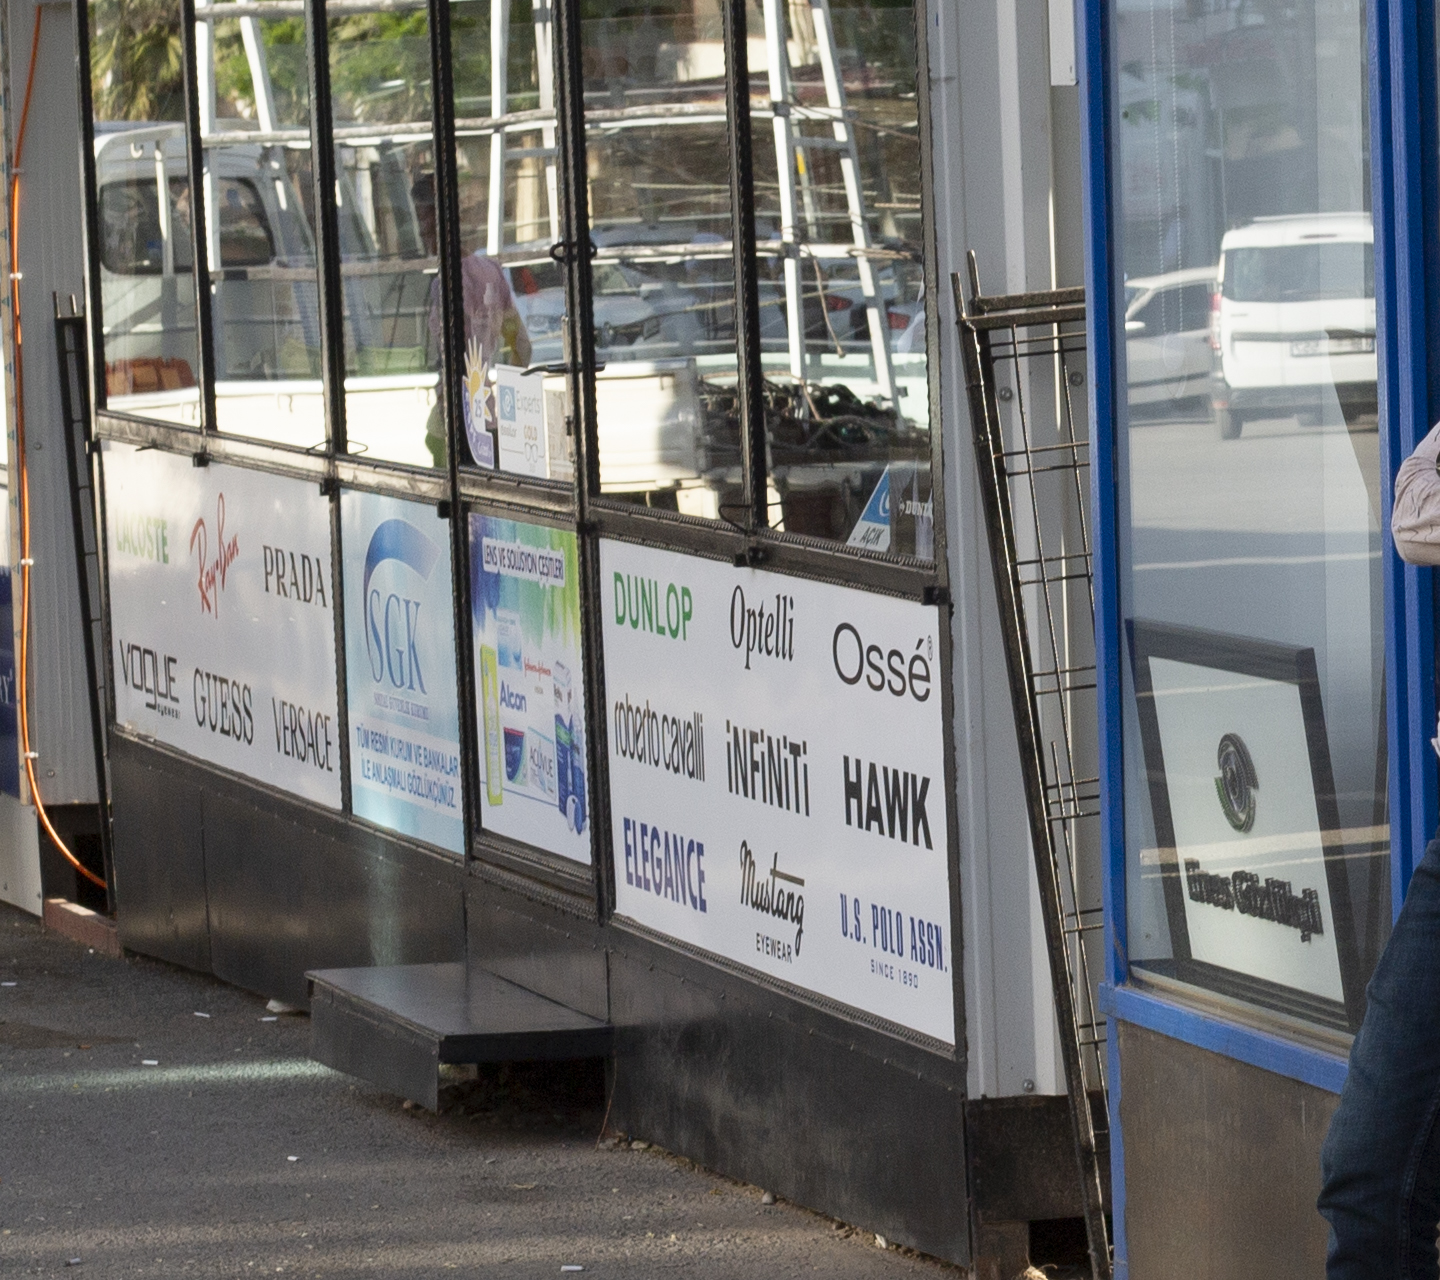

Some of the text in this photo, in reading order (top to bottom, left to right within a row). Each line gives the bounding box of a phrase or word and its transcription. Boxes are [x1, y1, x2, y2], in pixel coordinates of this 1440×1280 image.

[115, 510, 169, 564] LACOSTE
[484, 544, 497, 566] LENS
[498, 547, 506, 568] VE
[860, 526, 885, 549] AÇIK
[262, 545, 327, 608] PRADA
[613, 571, 693, 640] DUNLOP
[370, 589, 427, 695] SGK
[730, 585, 794, 670] Optelli
[833, 622, 931, 702] Ossé
[119, 639, 180, 710] VOGUE
[193, 667, 253, 745] GUESS
[500, 680, 527, 712] Alcon
[272, 696, 333, 772] VERSACE
[356, 723, 370, 749] TÜM
[389, 736, 413, 763] KURUM
[414, 743, 422, 766] VE
[423, 747, 459, 778] BANKALAR
[613, 693, 705, 782] roberto cavalli
[843, 755, 934, 850] HAWK
[623, 816, 707, 913] ELEGANCE
[740, 839, 805, 956] Mustang
[756, 933, 793, 964] EYEWEAR
[840, 893, 948, 973] U.S. POLO ASSN.
[870, 959, 918, 990] SINCE 1890
